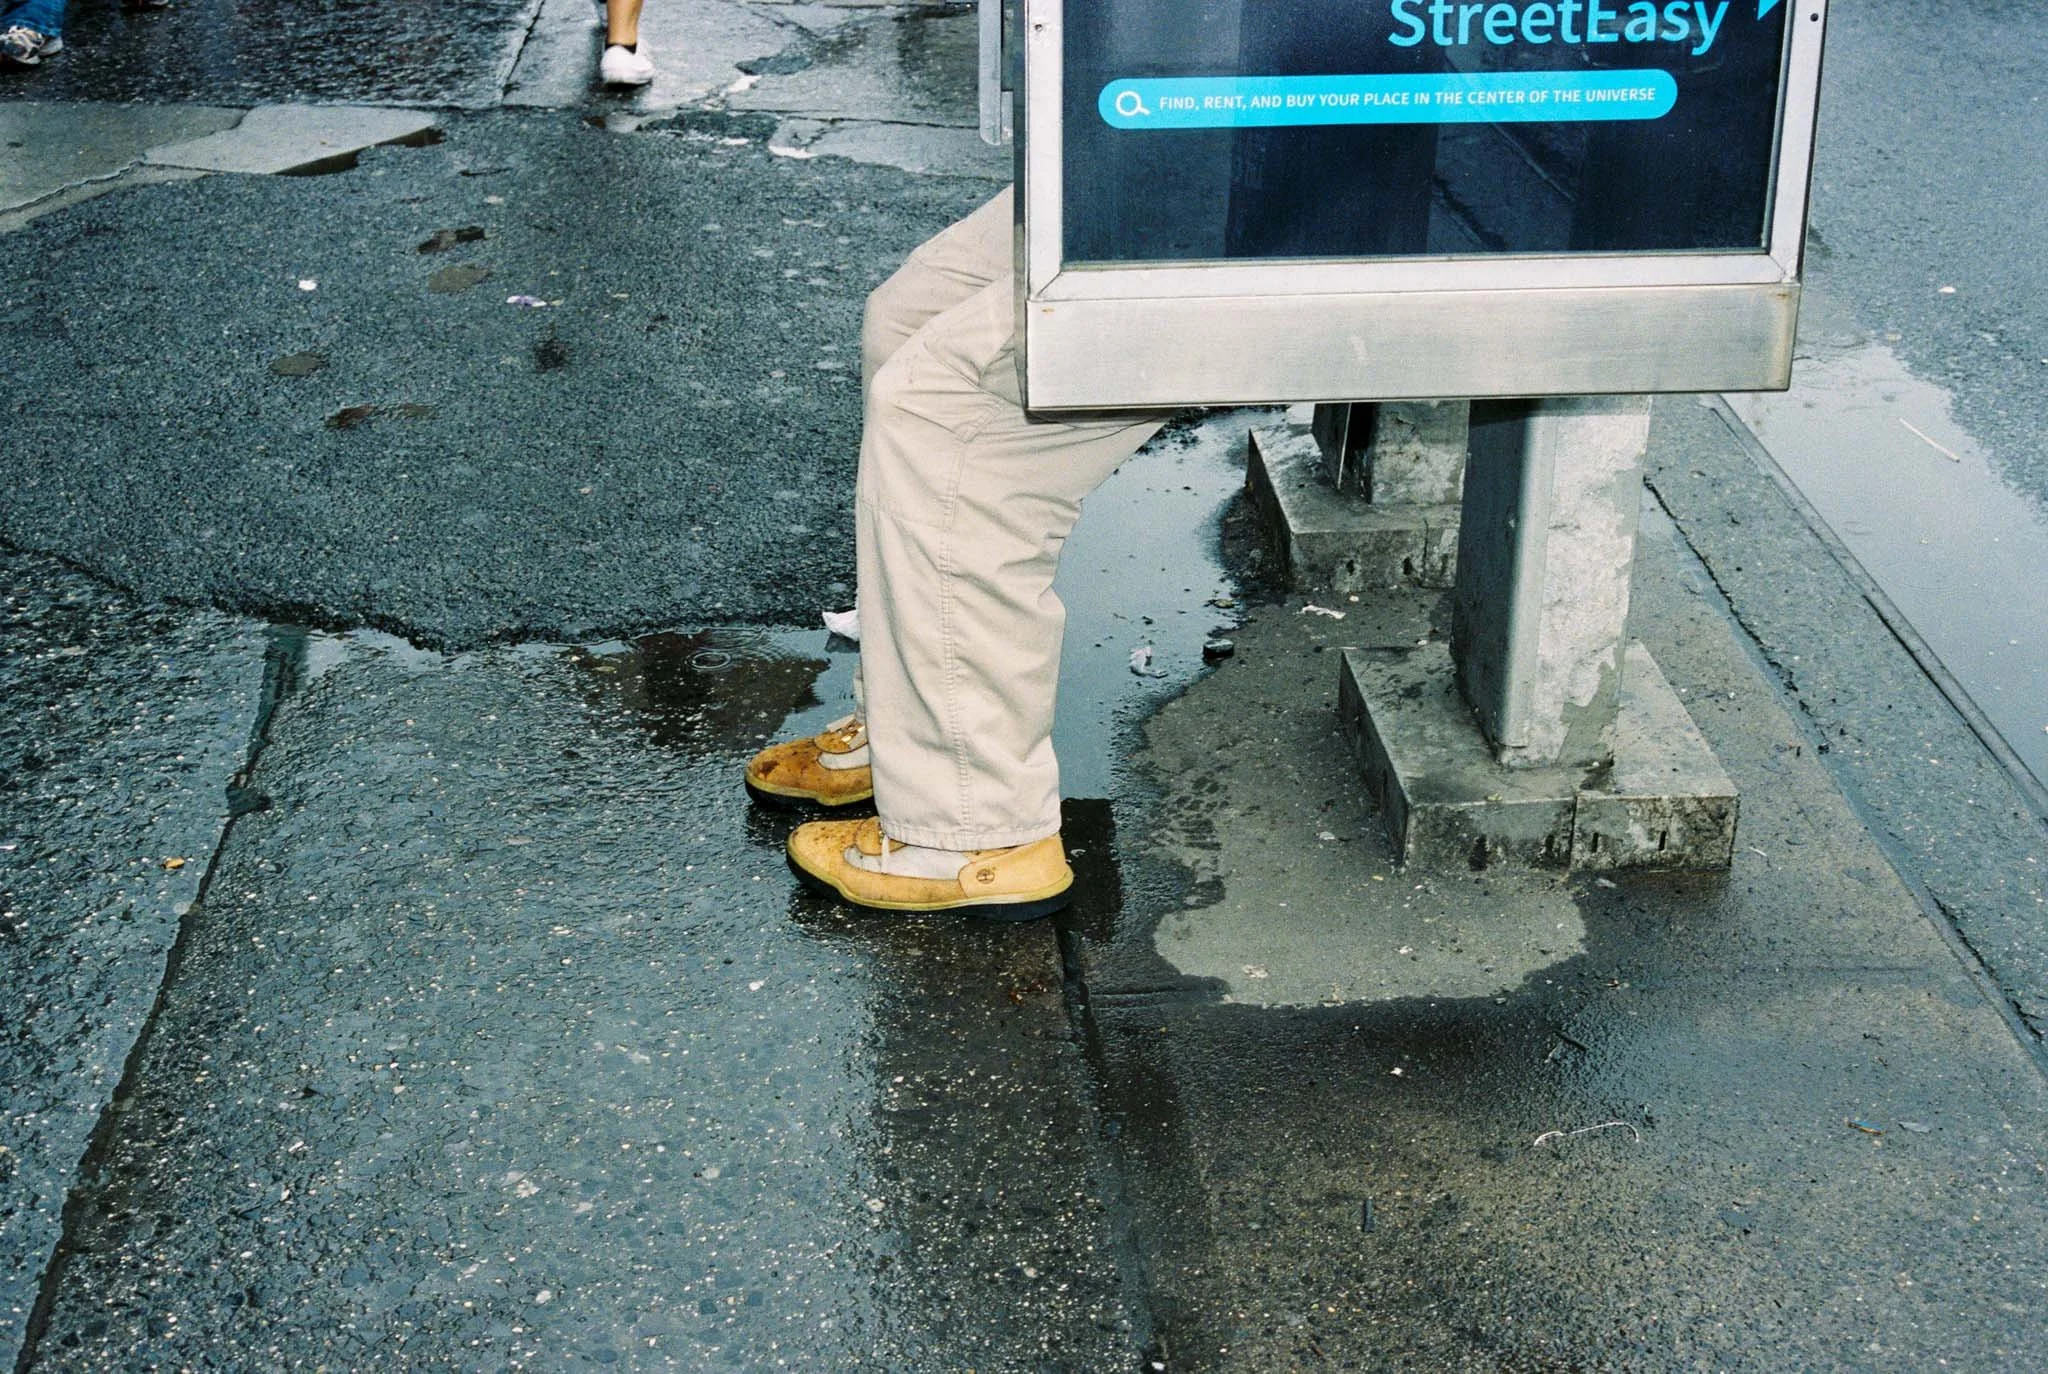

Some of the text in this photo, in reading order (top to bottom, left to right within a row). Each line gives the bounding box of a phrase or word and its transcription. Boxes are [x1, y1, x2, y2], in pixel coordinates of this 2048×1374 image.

[1388, 0, 1729, 56] StreetEasy
[1159, 88, 1656, 110] FIND, RENT, AND BUY YOUR PLACE IN THE CENTER OF THE UNIVERSE
